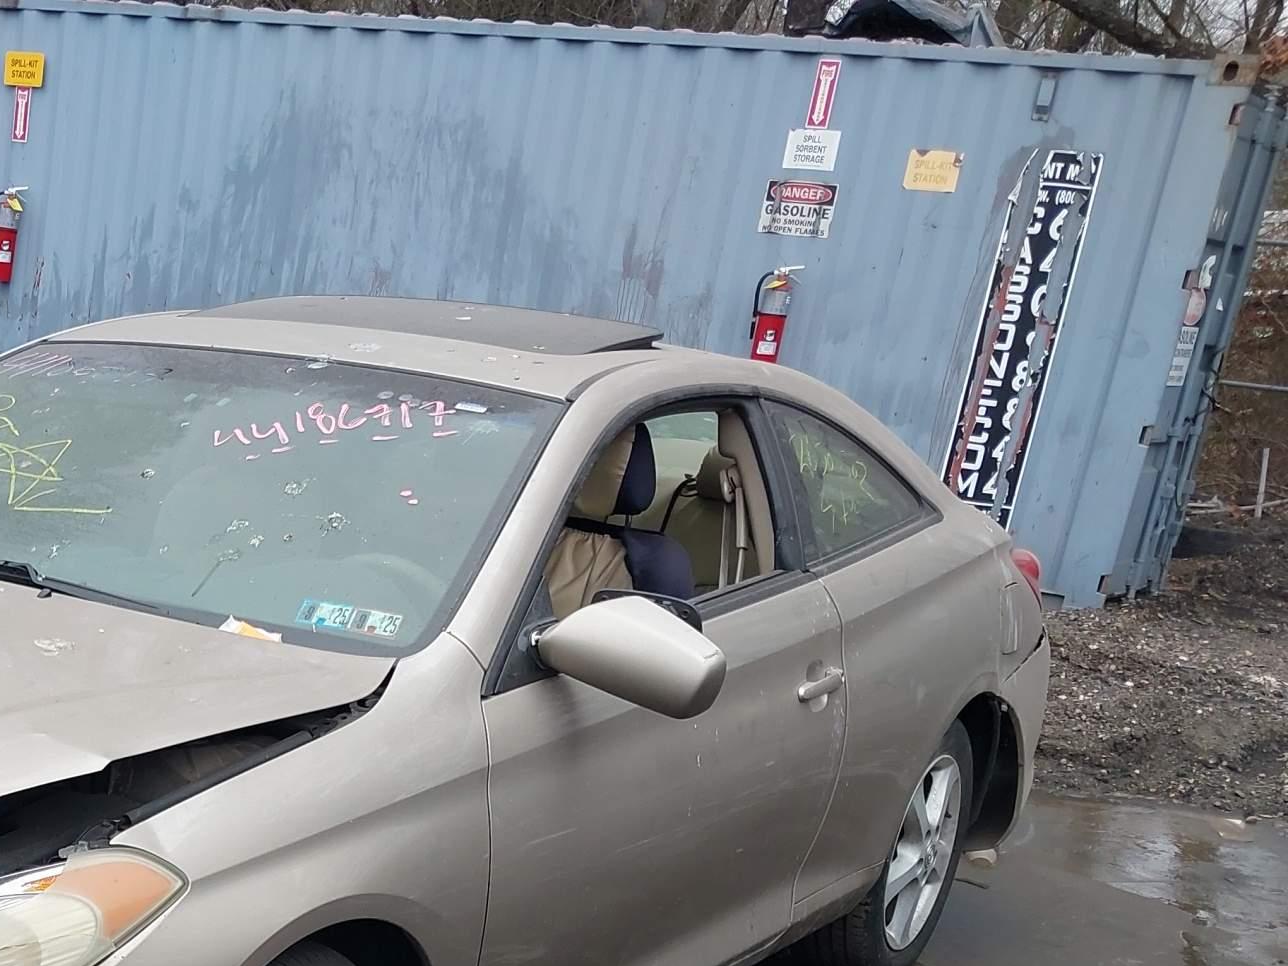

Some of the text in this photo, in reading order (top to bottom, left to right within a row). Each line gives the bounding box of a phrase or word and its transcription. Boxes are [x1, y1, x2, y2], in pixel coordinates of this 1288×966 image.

[11, 58, 38, 68] SPILL-KIT
[11, 70, 35, 79] STATION
[803, 135, 822, 143] SPILL
[795, 145, 827, 154] SORBENT
[793, 155, 825, 164] STORAGE
[914, 160, 953, 169] SPILL-KIT
[912, 173, 948, 184] STATION
[765, 203, 831, 220] GASOLINE
[774, 225, 793, 233] OPEN
